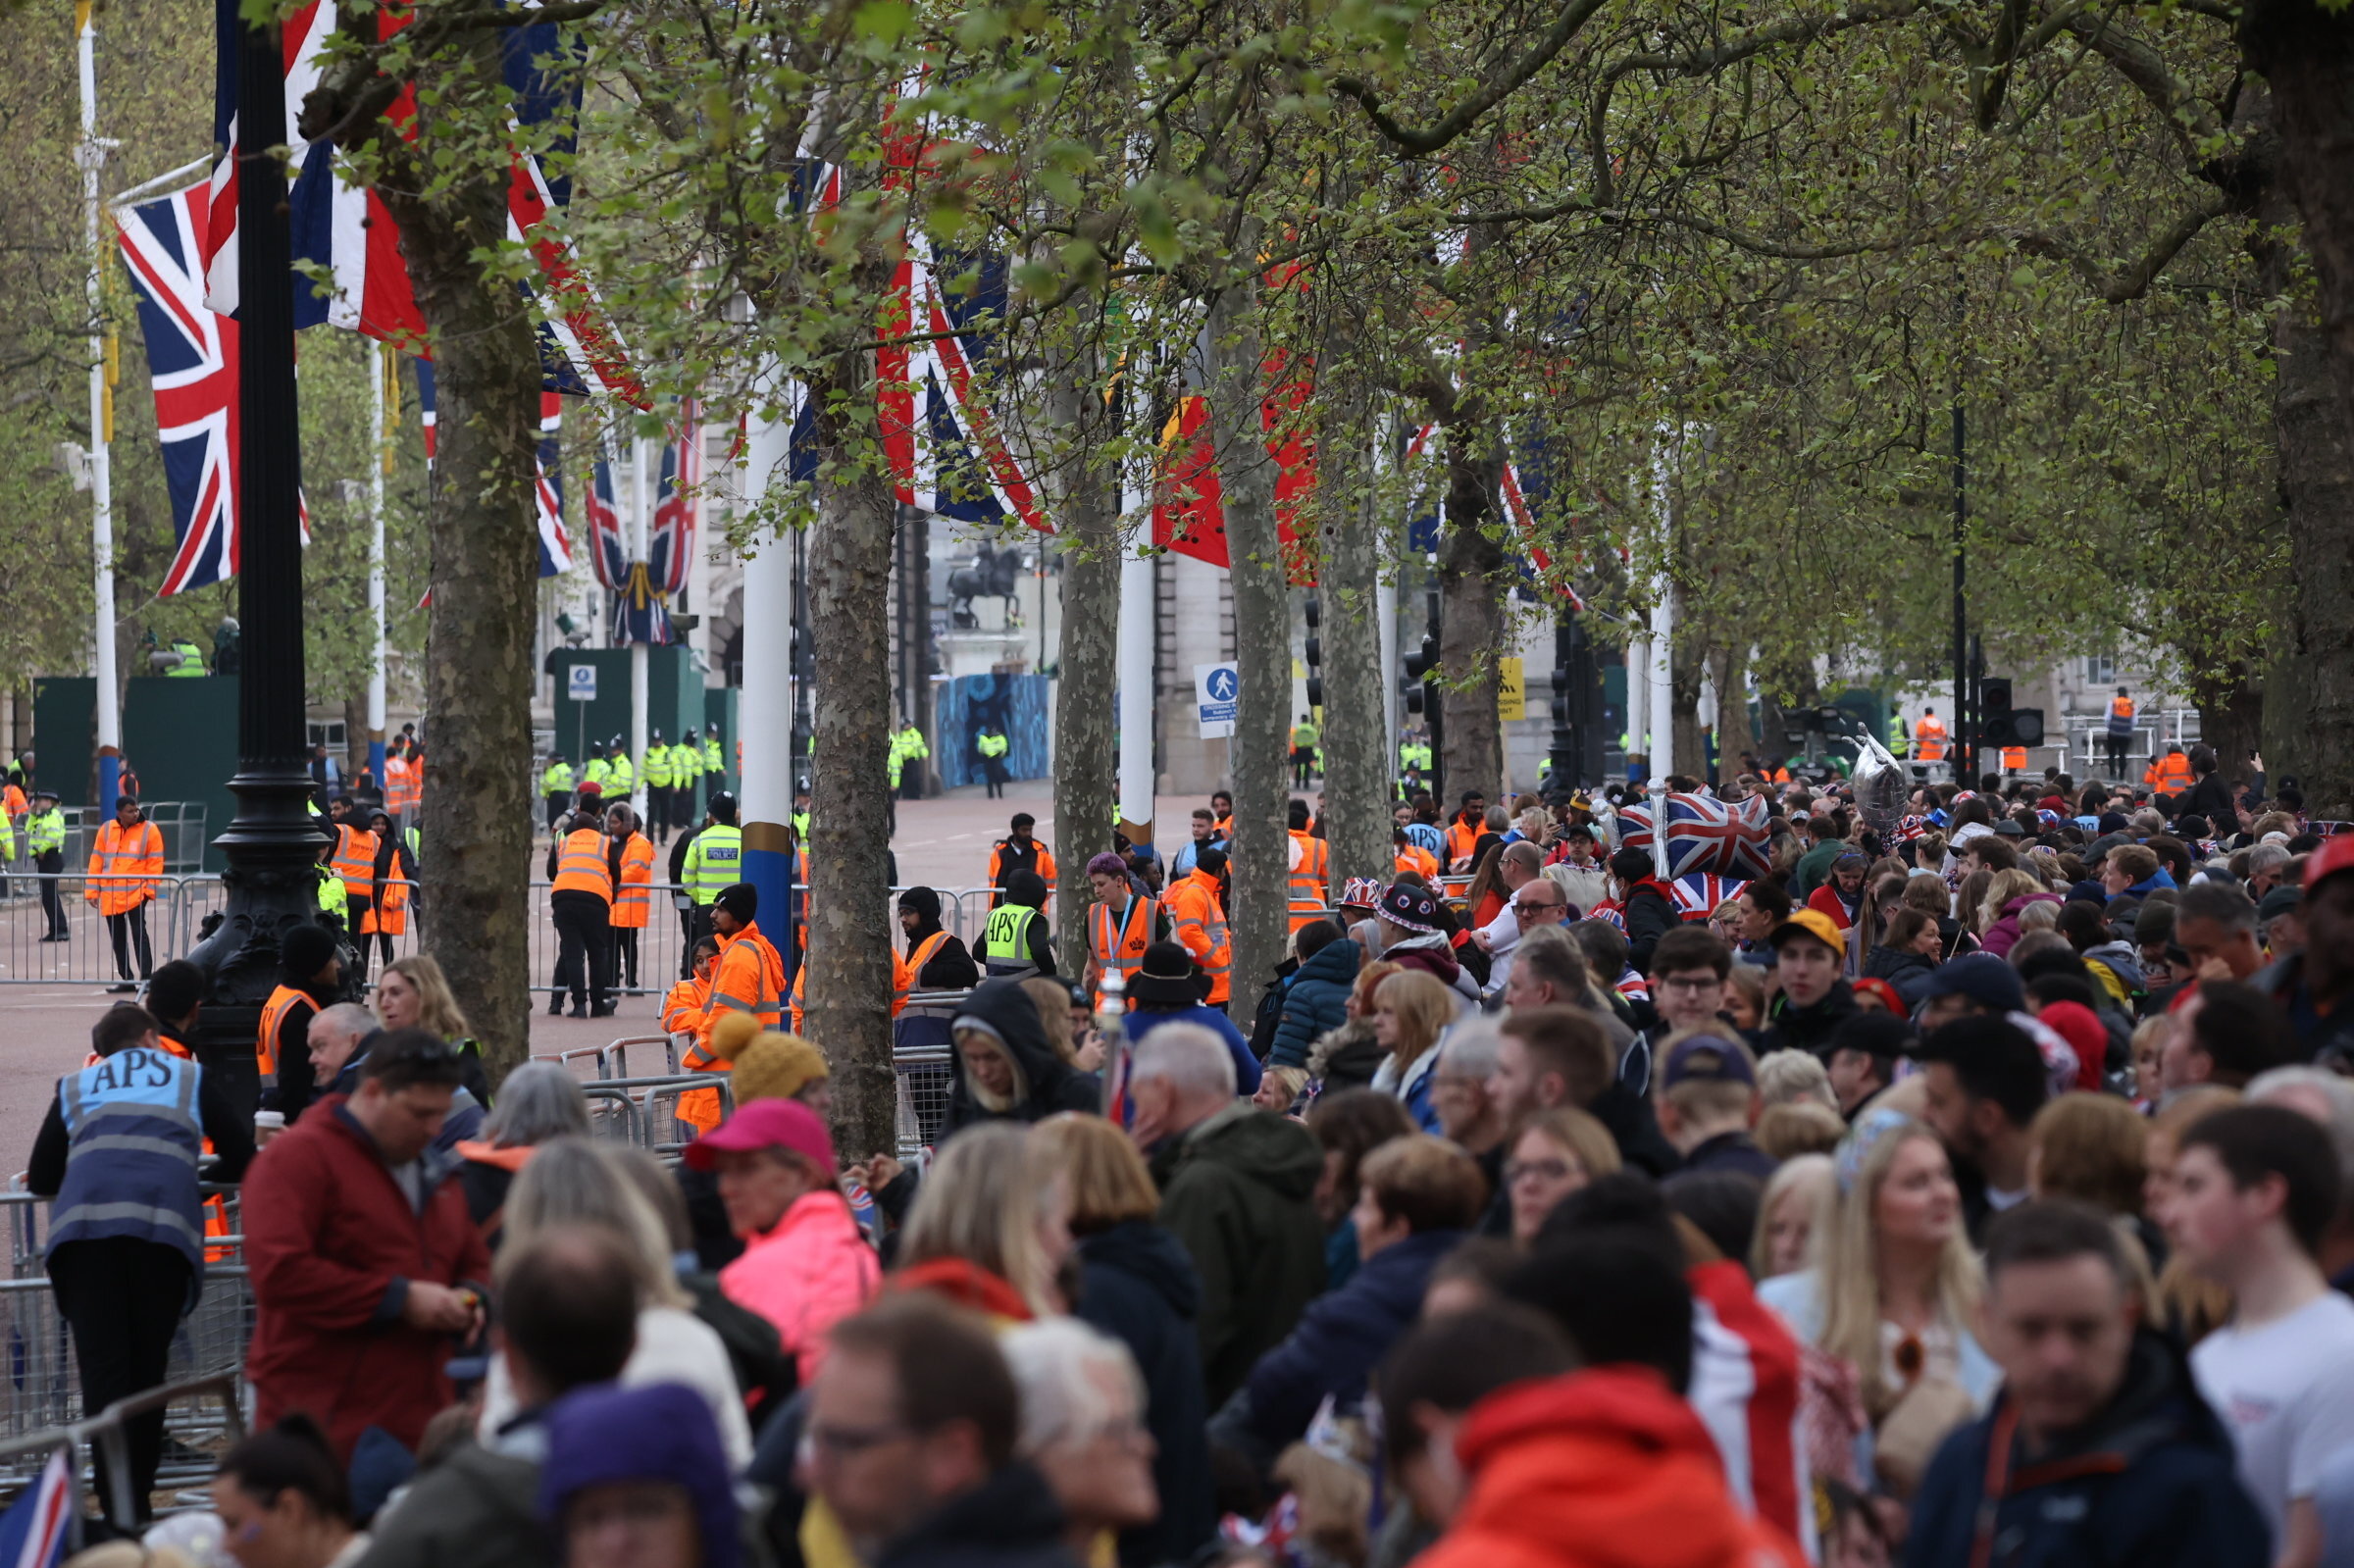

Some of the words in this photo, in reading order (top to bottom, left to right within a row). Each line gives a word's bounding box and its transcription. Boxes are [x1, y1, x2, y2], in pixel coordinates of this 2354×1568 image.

[1408, 829, 1437, 851] APS
[989, 913, 1018, 942] APS
[90, 1050, 172, 1094] APS
